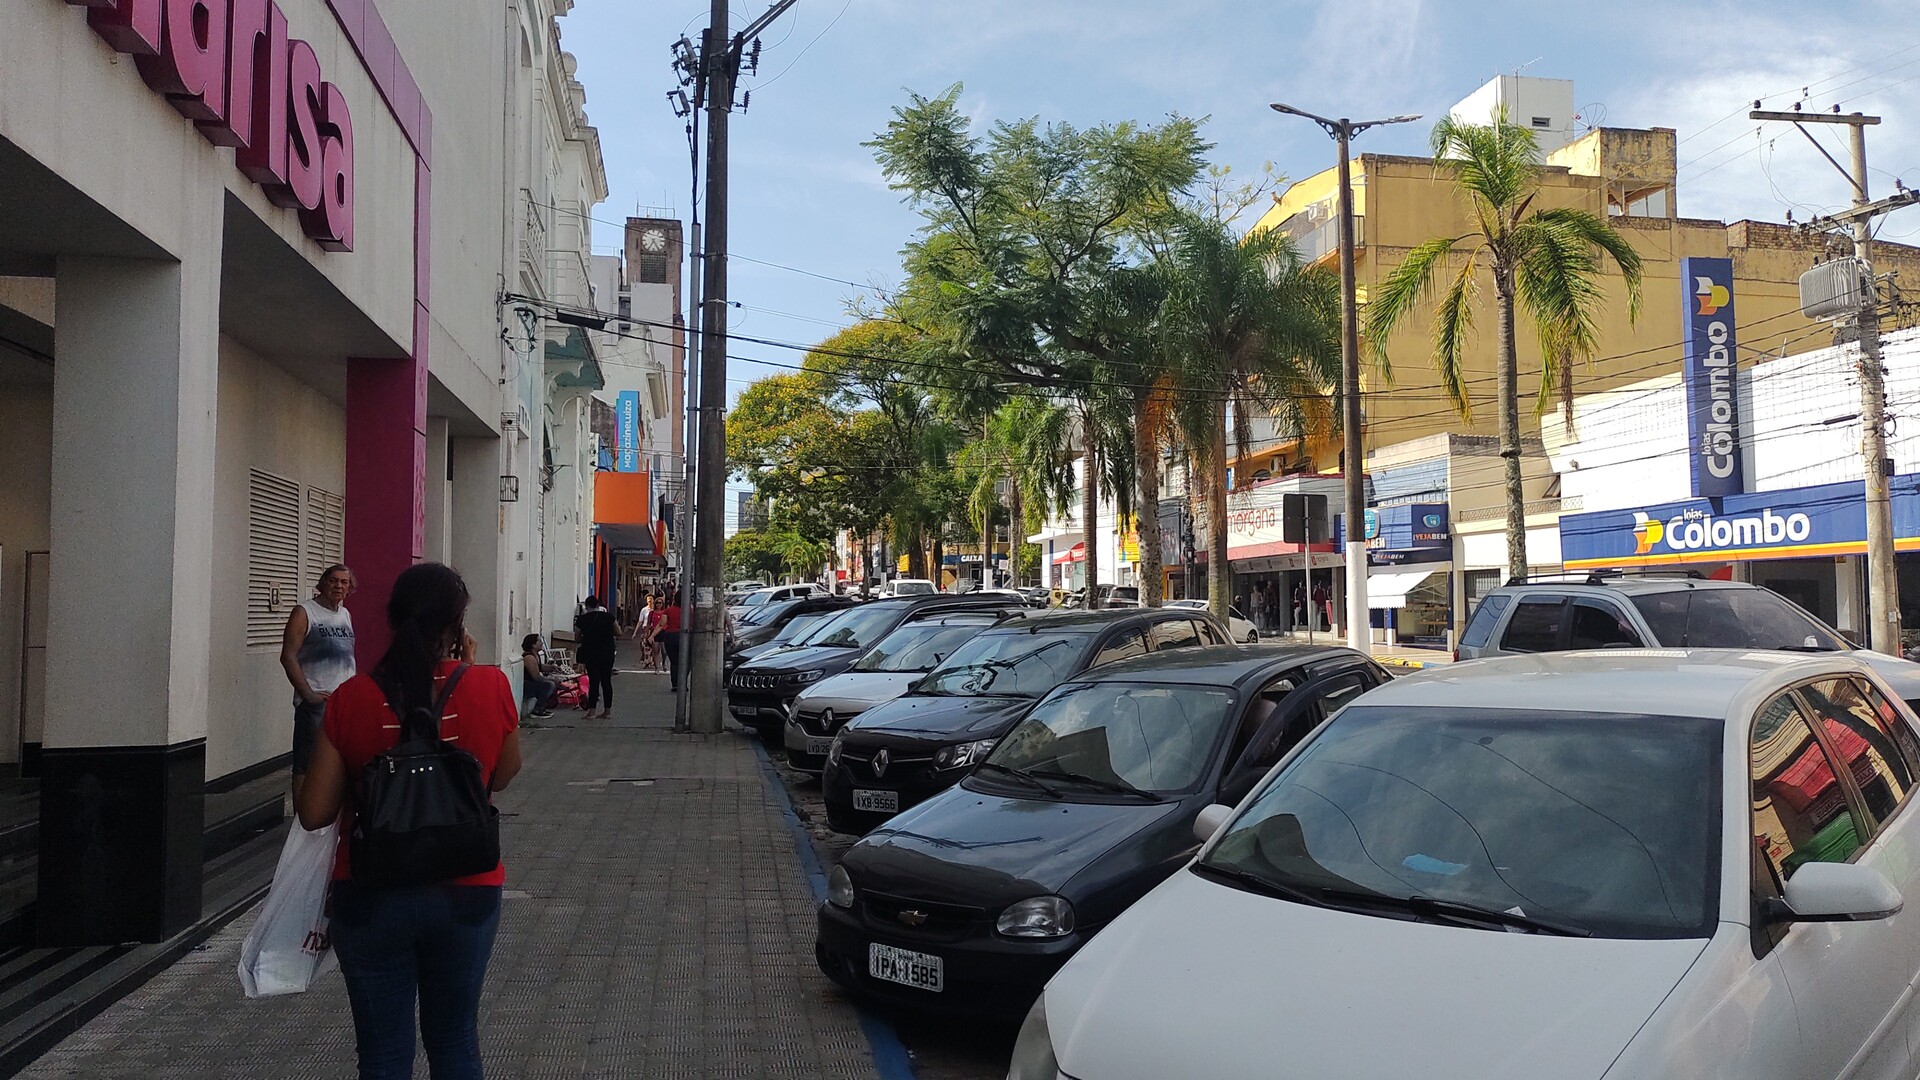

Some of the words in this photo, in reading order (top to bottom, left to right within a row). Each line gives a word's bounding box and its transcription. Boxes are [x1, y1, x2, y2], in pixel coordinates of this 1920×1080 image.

[1703, 321, 1735, 478] Colombo
[1702, 432, 1711, 455] lojas
[1683, 509, 1703, 522] lojas
[1666, 508, 1810, 550] Colombo
[319, 627, 349, 638] BLACK
